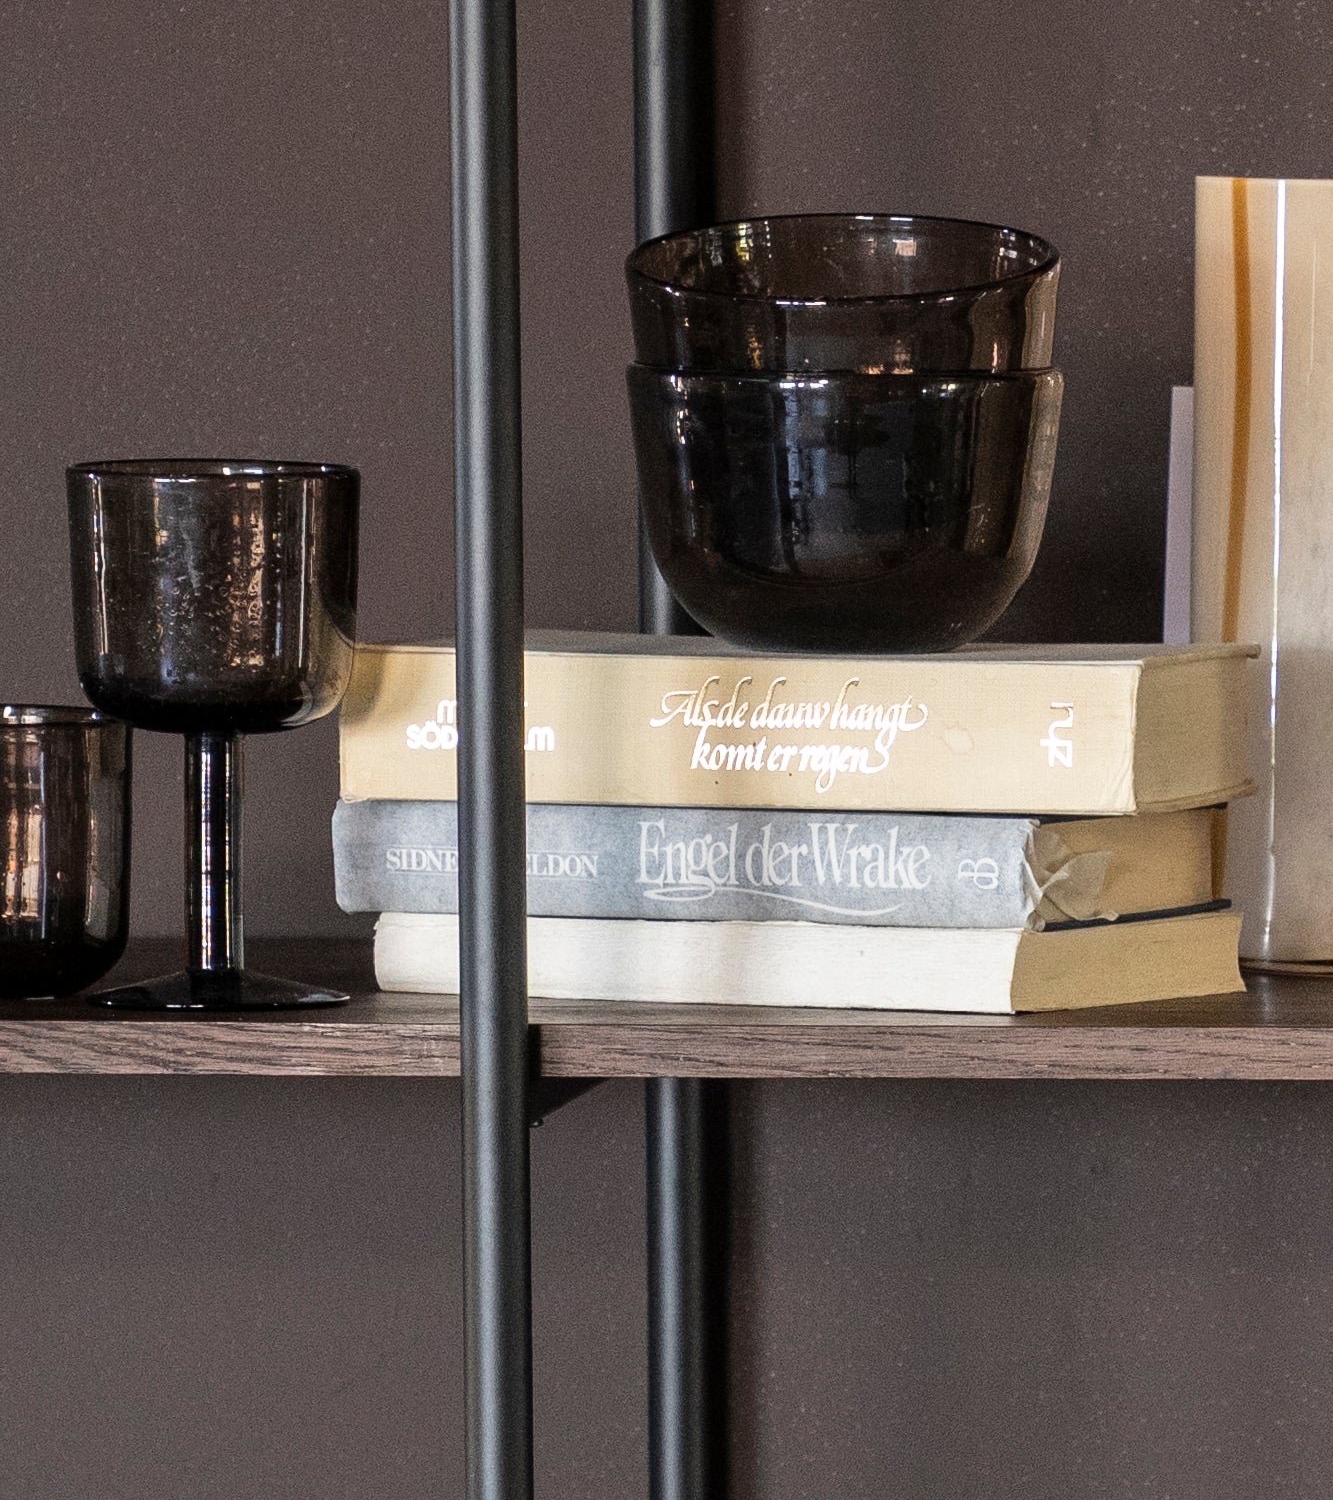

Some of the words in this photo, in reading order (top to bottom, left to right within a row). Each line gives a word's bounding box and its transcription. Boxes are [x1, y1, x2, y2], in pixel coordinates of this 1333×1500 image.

[649, 676, 719, 728] Als
[717, 676, 752, 728] de
[750, 676, 830, 730] dauw
[829, 676, 929, 748] hangt
[690, 725, 767, 771] komt
[767, 743, 801, 772] er
[798, 743, 889, 794] regen
[383, 850, 459, 872] SIDNE
[635, 818, 740, 900] Engel
[745, 822, 807, 888] der
[807, 822, 931, 890] Wrake
